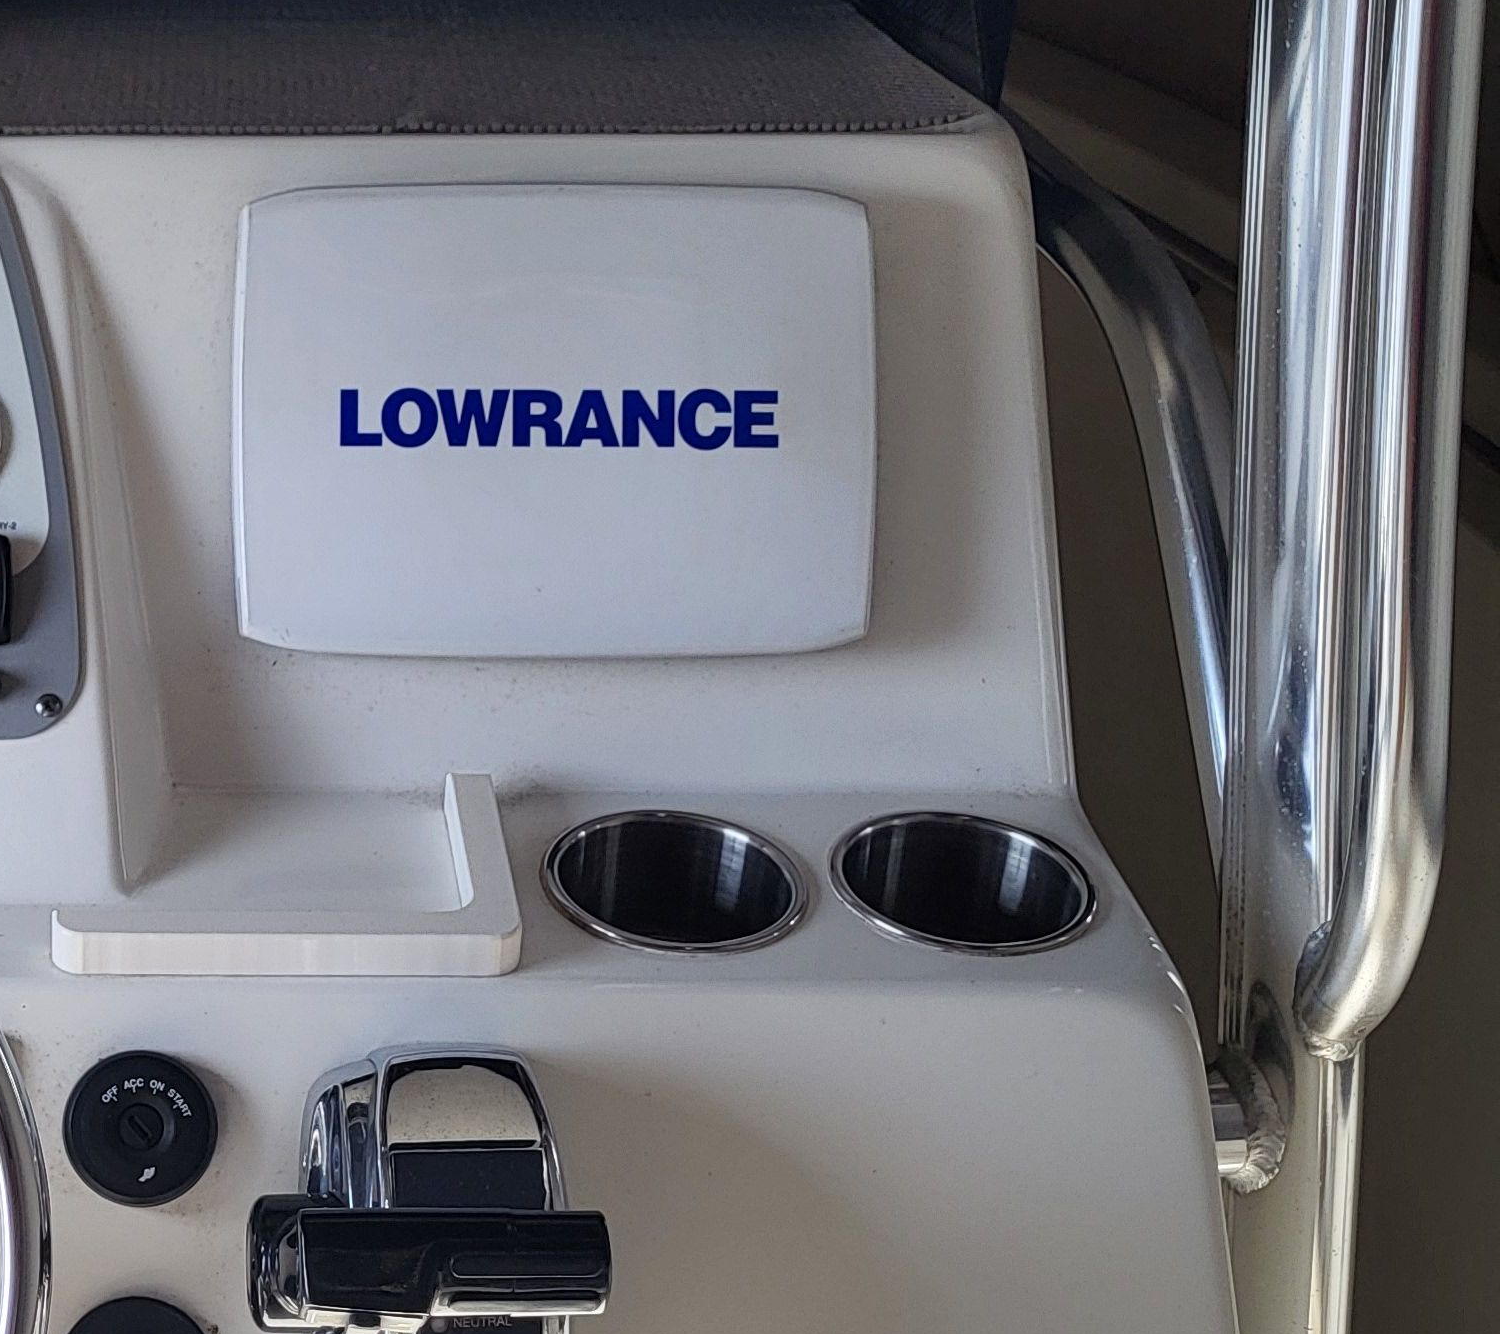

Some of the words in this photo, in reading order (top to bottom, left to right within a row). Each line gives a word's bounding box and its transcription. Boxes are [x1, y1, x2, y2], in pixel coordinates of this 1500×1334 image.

[339, 387, 779, 451] LOWRANCE
[123, 1077, 145, 1090] ACC
[149, 1079, 165, 1092] ON
[101, 1085, 119, 1103] OFF
[167, 1088, 192, 1118] START
[453, 1317, 513, 1328] NEUTRAL
